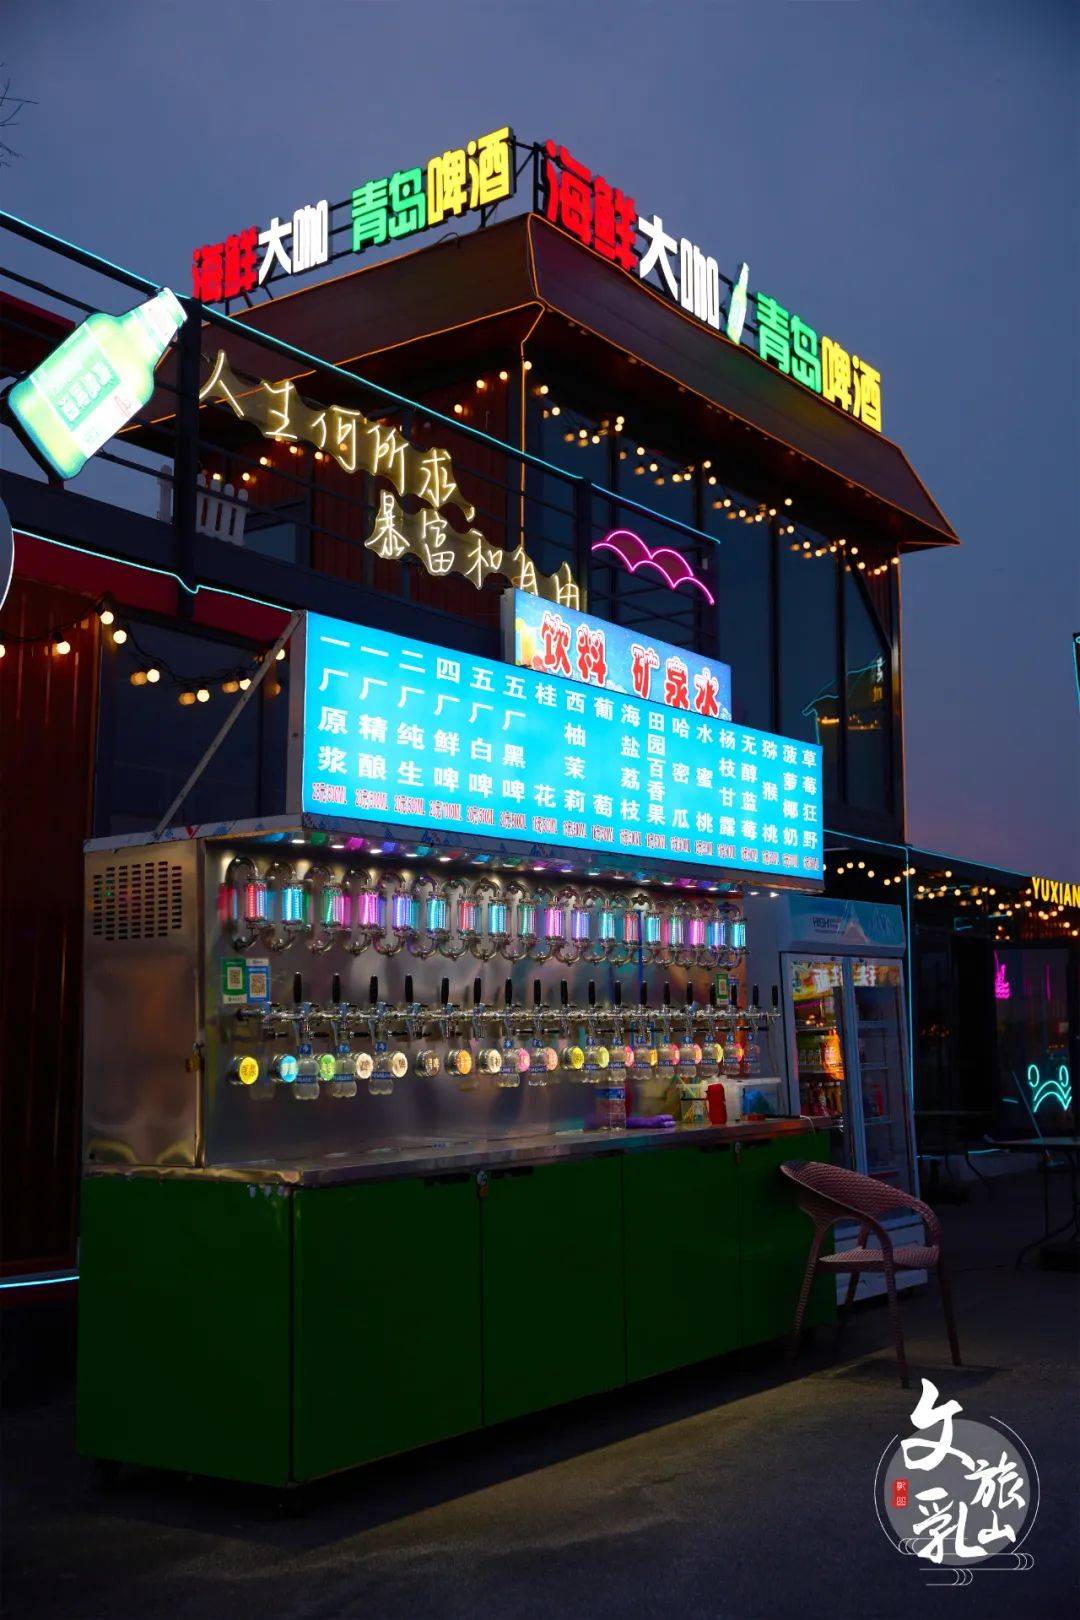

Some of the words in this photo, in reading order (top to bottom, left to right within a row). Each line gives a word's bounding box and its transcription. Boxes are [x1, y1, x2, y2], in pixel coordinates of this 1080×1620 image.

[192, 200, 328, 302] 海鲜大咖
[352, 127, 513, 251] 青岛啤酒
[544, 139, 720, 330] 海鲜大咖
[756, 290, 883, 433] 青岛啤酒
[317, 635, 350, 775] 一厂原浆
[358, 645, 389, 782] 一厂精酿
[396, 649, 425, 788] 二厂纯生
[434, 657, 461, 793] 四厂鲜啤
[541, 611, 607, 688] 饮料
[631, 643, 719, 718] 矿泉水
[469, 666, 495, 799] 五厂白啤
[502, 674, 527, 804] 五厂黑啤
[564, 689, 586, 813] 西柚茉莉
[621, 703, 641, 822] 海盐荔枝
[647, 711, 666, 826] 田园百香果
[672, 717, 690, 830] 哈密瓜
[696, 723, 714, 834] 水蜜桃
[719, 728, 736, 838] 杨枝甘露
